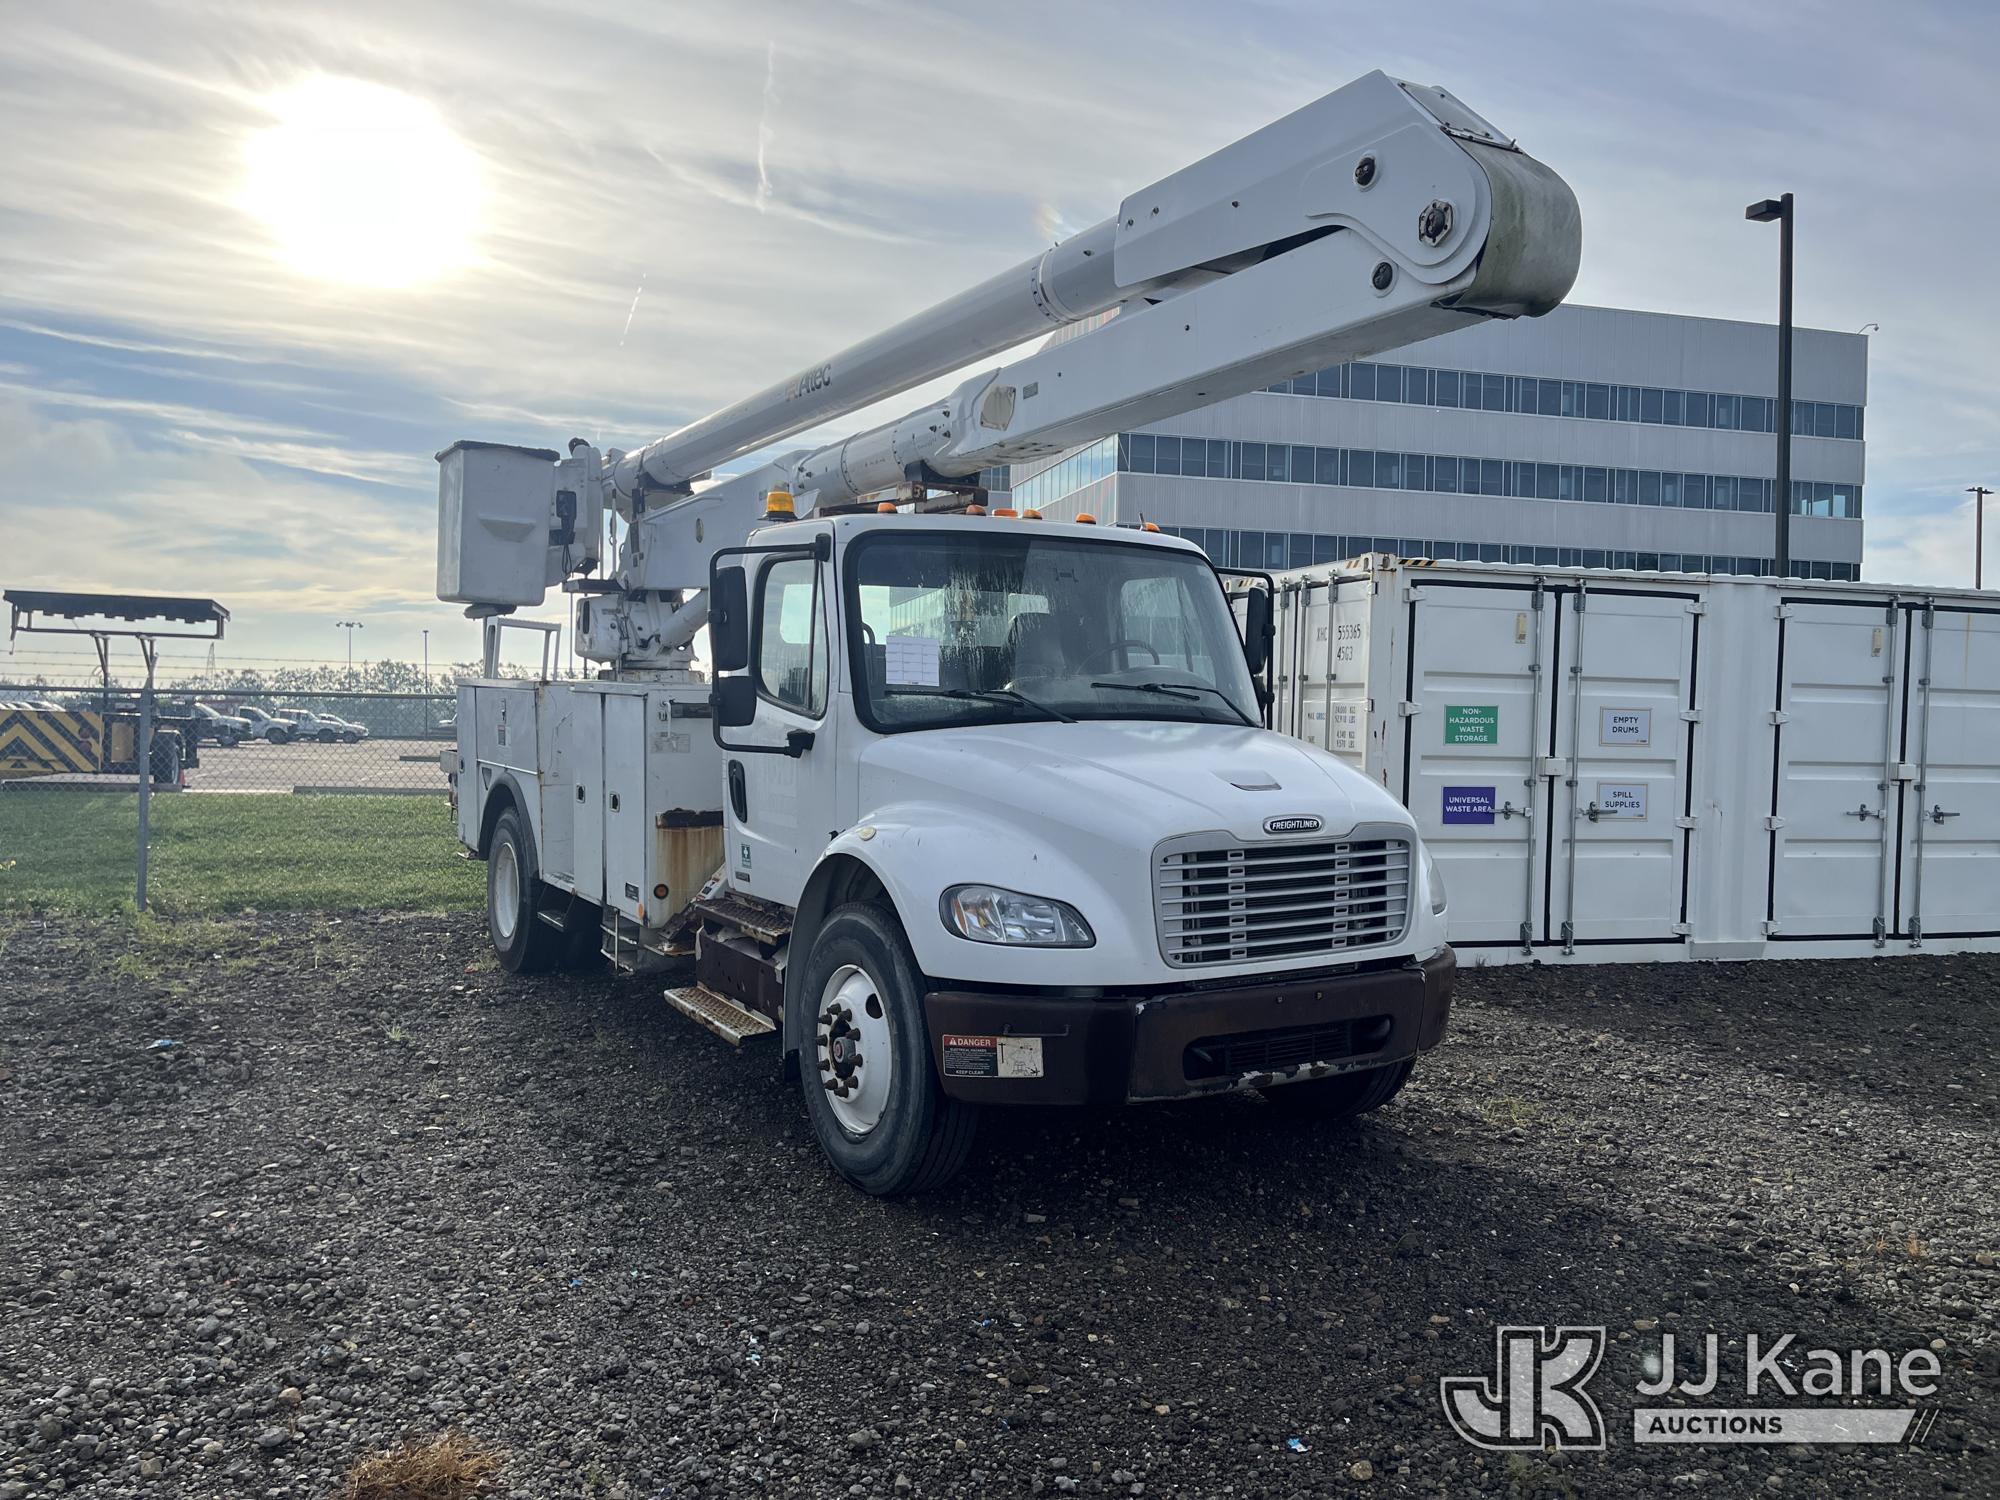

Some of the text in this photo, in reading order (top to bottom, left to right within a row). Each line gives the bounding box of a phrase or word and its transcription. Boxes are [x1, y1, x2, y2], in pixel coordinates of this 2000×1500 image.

[799, 363, 831, 397] Altec
[1337, 624, 1361, 640] 555365
[1613, 716, 1639, 724] EMPTY
[1612, 726, 1640, 734] DRUMS
[1612, 791, 1634, 799] SPILL
[1448, 796, 1490, 804] UNIVERSAL
[1604, 800, 1641, 809] SUPPLIES
[1445, 805, 1493, 813] WASTE AREA
[1271, 820, 1318, 830] FREIGHTLINER
[957, 1038, 991, 1046] DANGER
